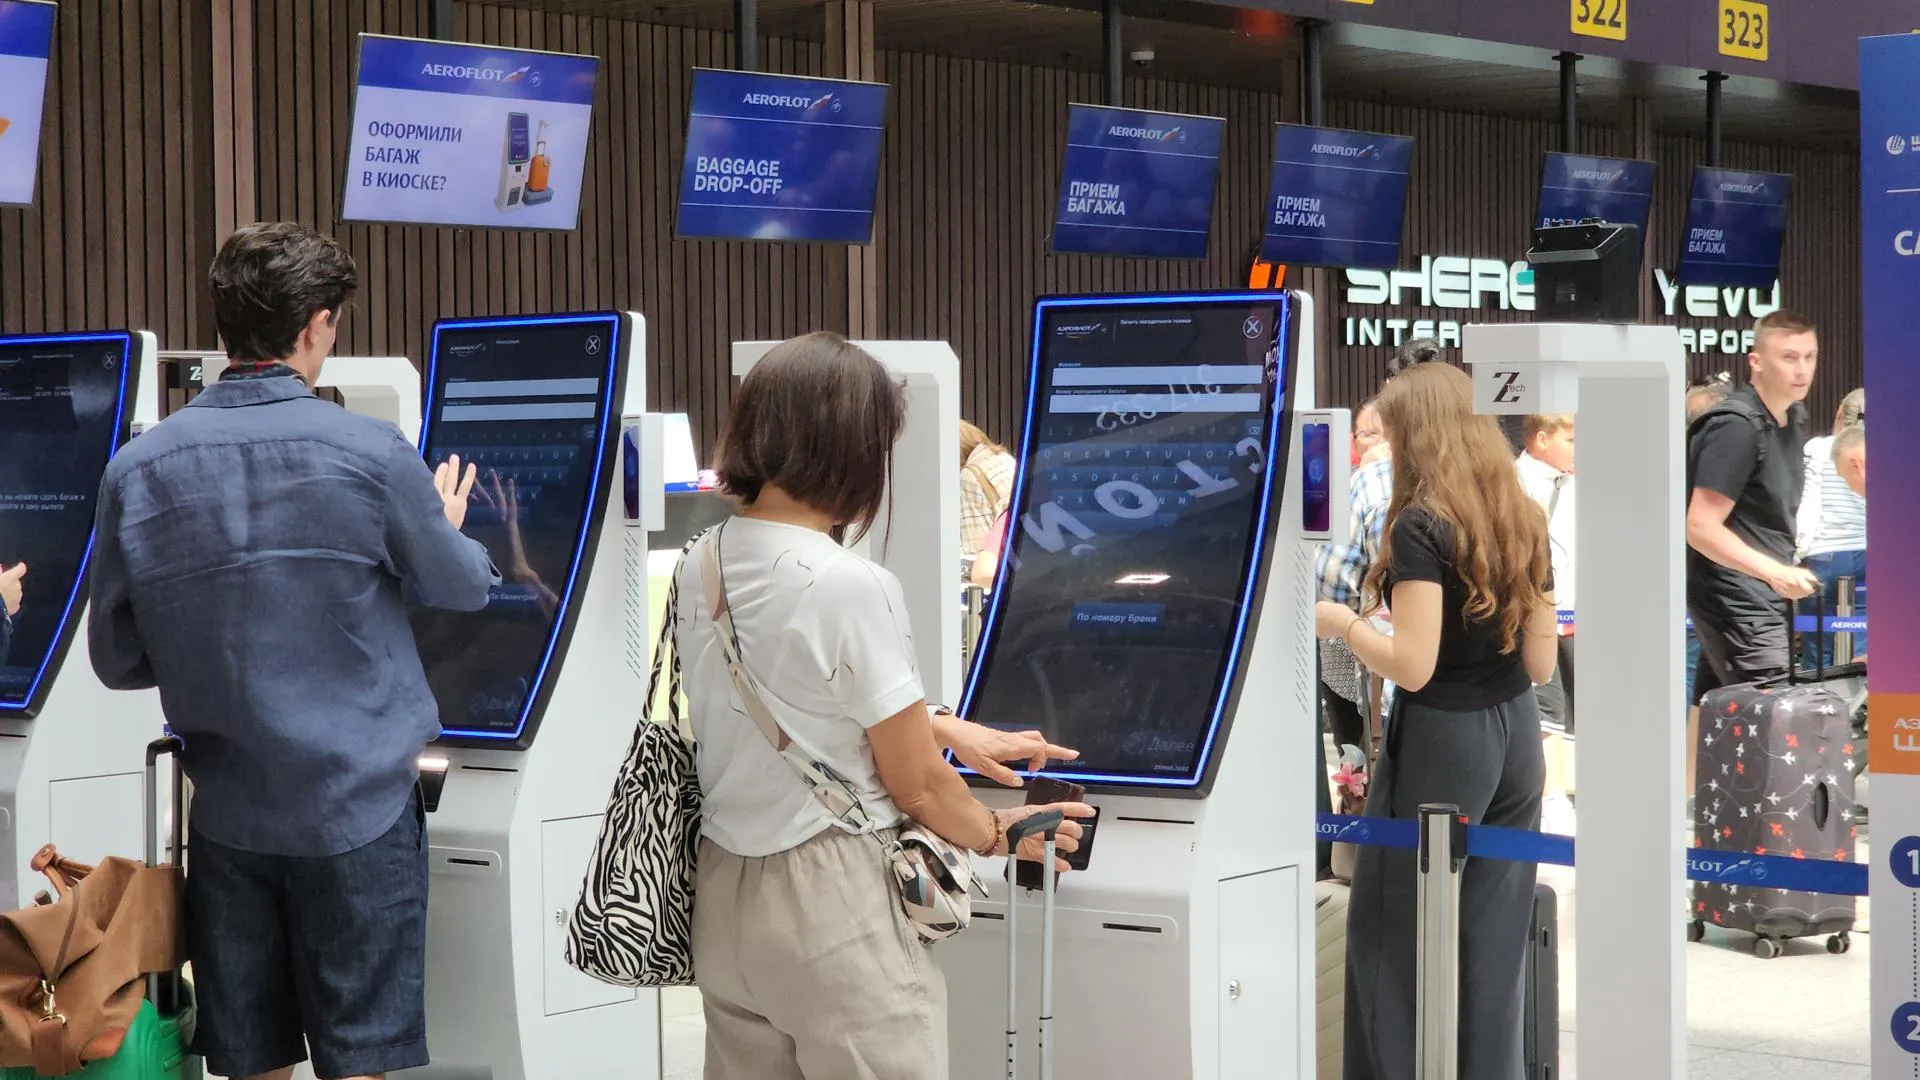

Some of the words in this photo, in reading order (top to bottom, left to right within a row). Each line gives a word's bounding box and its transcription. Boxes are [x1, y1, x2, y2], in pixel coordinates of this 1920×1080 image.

[1576, 0, 1622, 28] 322
[1723, 8, 1764, 49] 323
[421, 63, 504, 81] AEROFLOT
[743, 93, 811, 108] AEROFLOT
[368, 120, 462, 143] ОФОРМИЛИ
[1108, 126, 1162, 140] AEROFLOT
[365, 146, 421, 165] БАГАЖ
[1311, 143, 1358, 157] AEROFLOT
[696, 156, 780, 177] BAGGAGE
[1572, 169, 1611, 181] AEROFLOT
[362, 171, 372, 187] В
[376, 172, 447, 191] КИОСКЕ?
[694, 174, 783, 195] DROP-OFF
[1069, 181, 1120, 199] ПРИЕМ
[1719, 183, 1753, 193] AEROFLOT
[1067, 197, 1126, 216] БАГАЖА
[1276, 195, 1321, 212] ПРИЕМ
[1274, 210, 1326, 228] БАГАЖА
[1690, 228, 1724, 241] ПРИЕМ
[1894, 230, 1920, 256] С
[1688, 240, 1726, 254] БАГАЖА
[1076, 612, 1089, 621] По
[1091, 614, 1126, 624] номеру
[1128, 613, 1157, 624] брони
[1148, 737, 1194, 753] Далее
